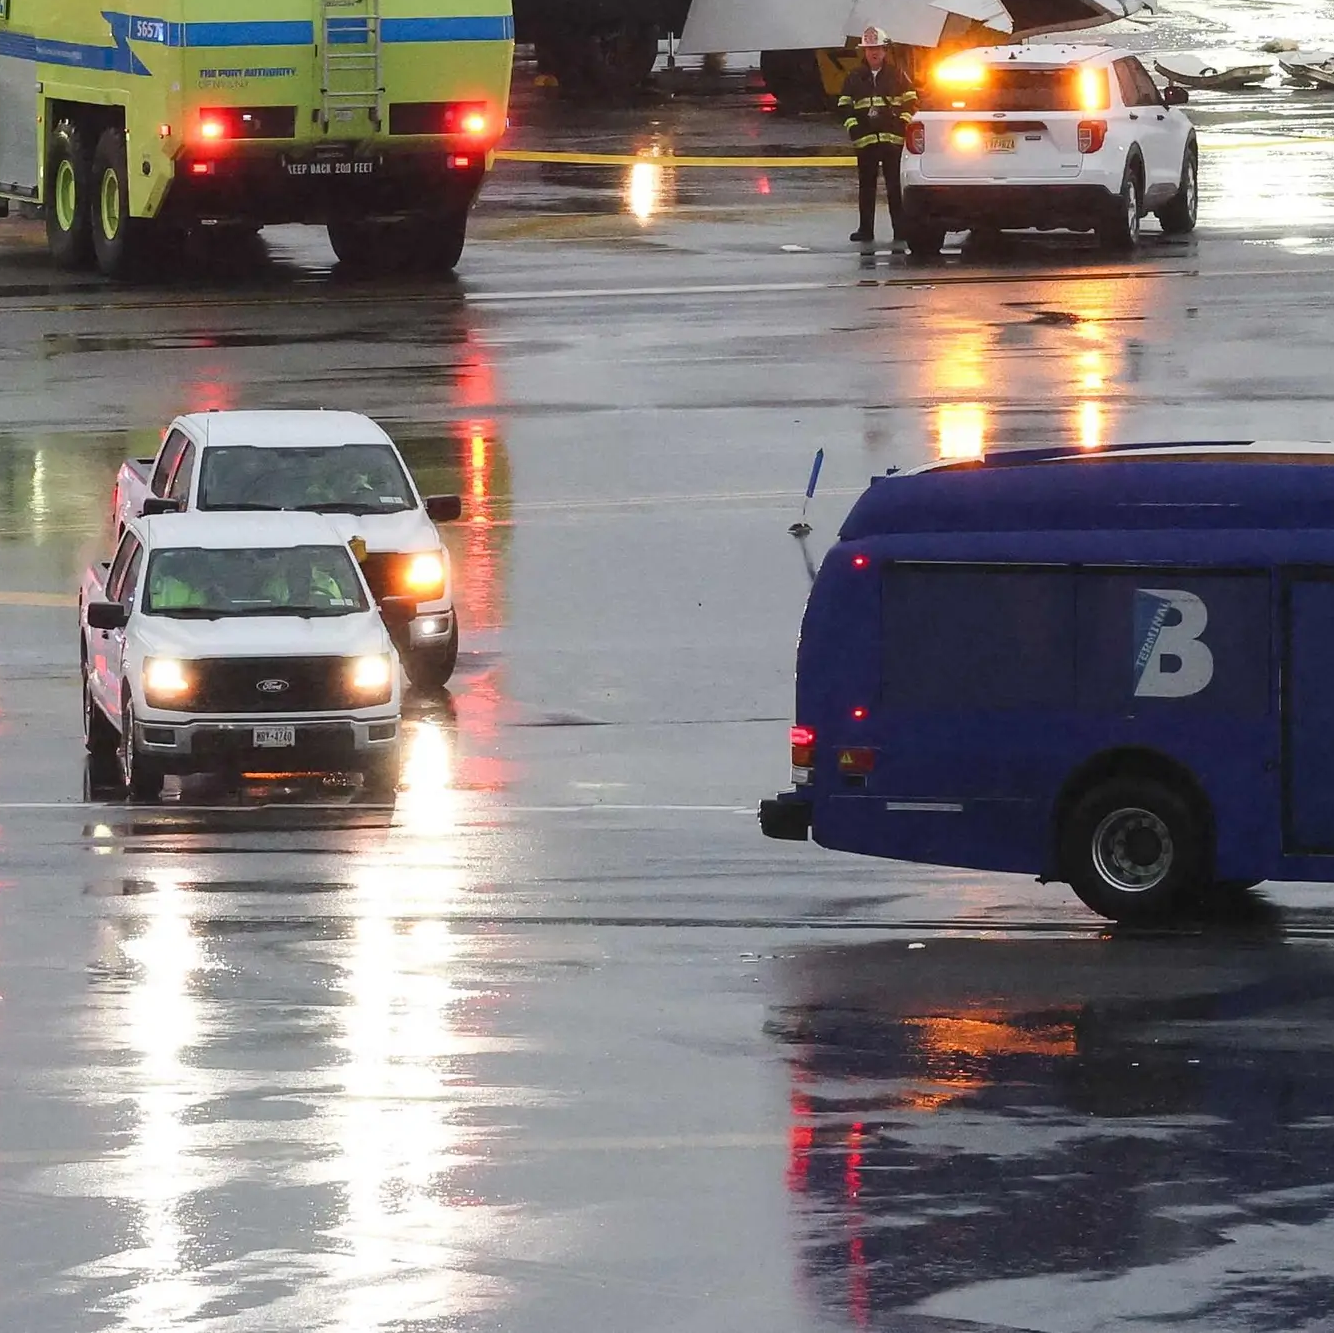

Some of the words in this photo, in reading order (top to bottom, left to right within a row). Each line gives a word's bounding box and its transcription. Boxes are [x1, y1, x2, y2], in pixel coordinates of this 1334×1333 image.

[199, 69, 216, 78] THE
[218, 68, 242, 77] PORT
[244, 67, 295, 77] AUTHORITY
[287, 164, 307, 175] KEEP
[310, 163, 332, 174] BACK
[354, 162, 372, 173] FEET
[1135, 601, 1171, 667] TERMINAL
